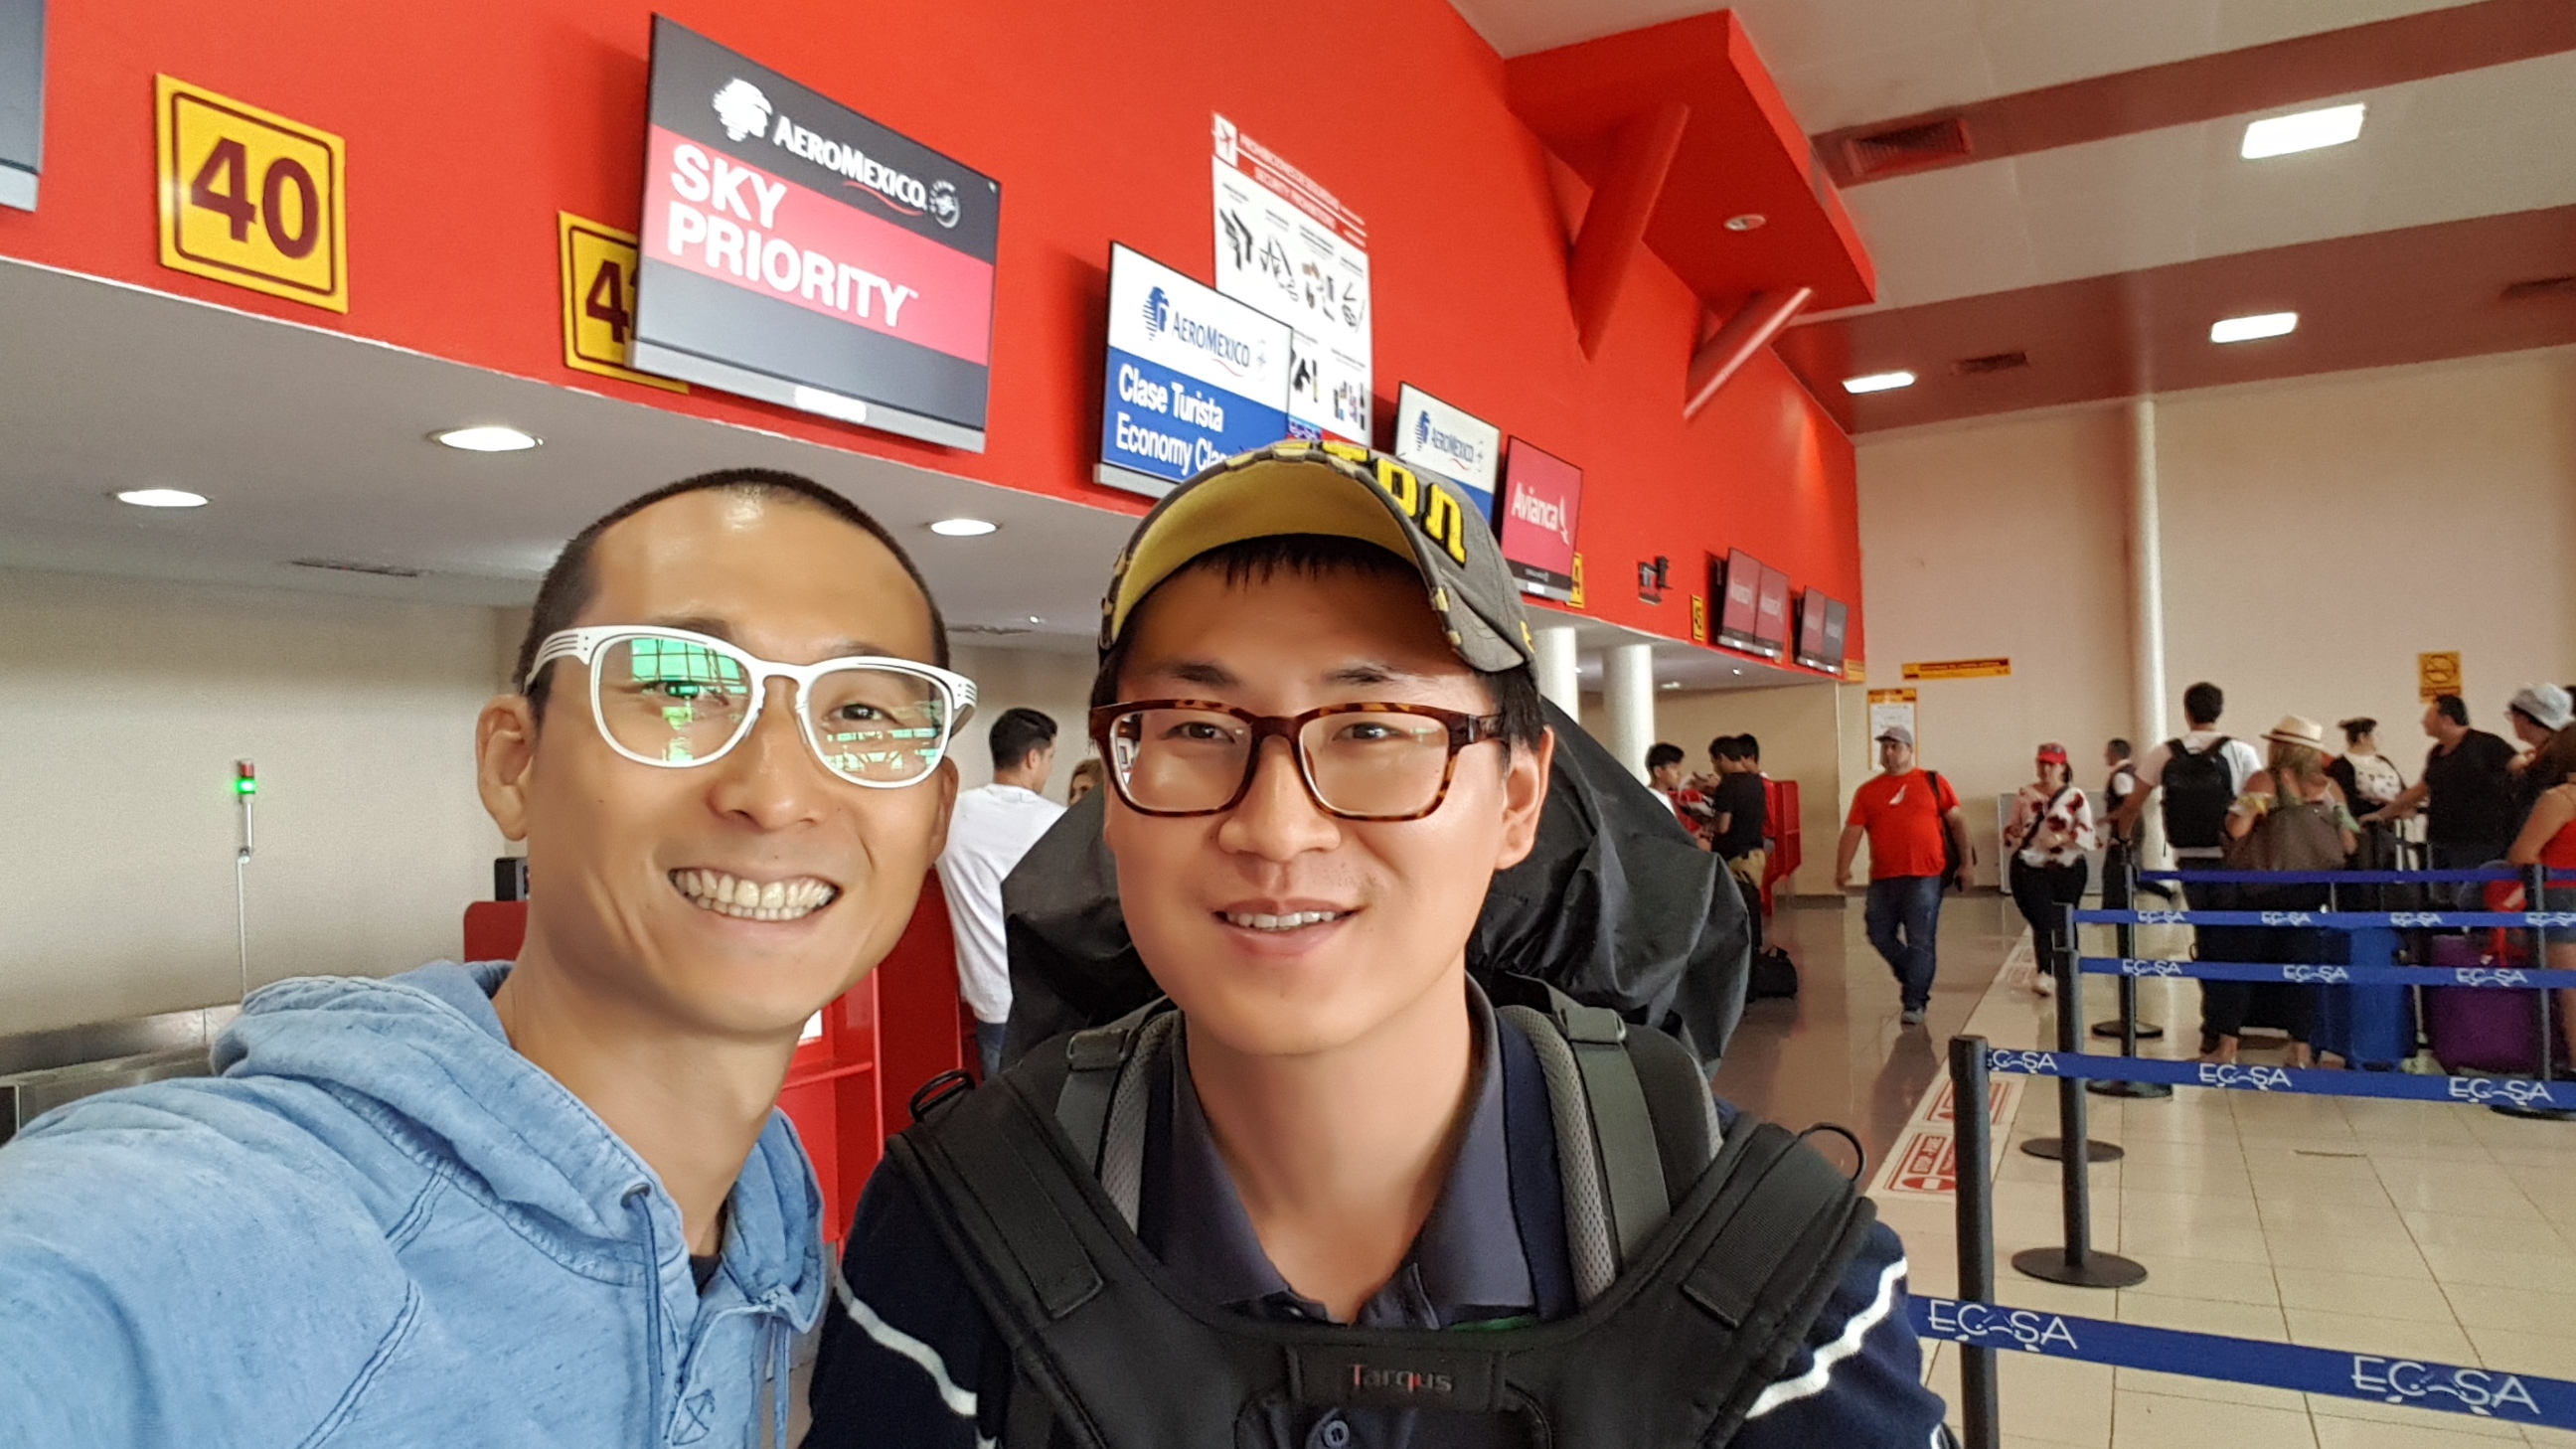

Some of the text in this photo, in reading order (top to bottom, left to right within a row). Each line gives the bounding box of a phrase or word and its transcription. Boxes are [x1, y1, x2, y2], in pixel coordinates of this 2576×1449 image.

[191, 137, 319, 259] 40
[671, 144, 787, 229] SKY
[772, 114, 927, 211] AEROMEXICO
[585, 258, 637, 345] 4
[668, 201, 914, 327] PRIORITY
[1172, 311, 1250, 368] AEROMEXICO
[1118, 363, 1224, 432] Clase Turista
[1116, 411, 1234, 476] Economy Cla
[1511, 482, 1558, 531] Avianca
